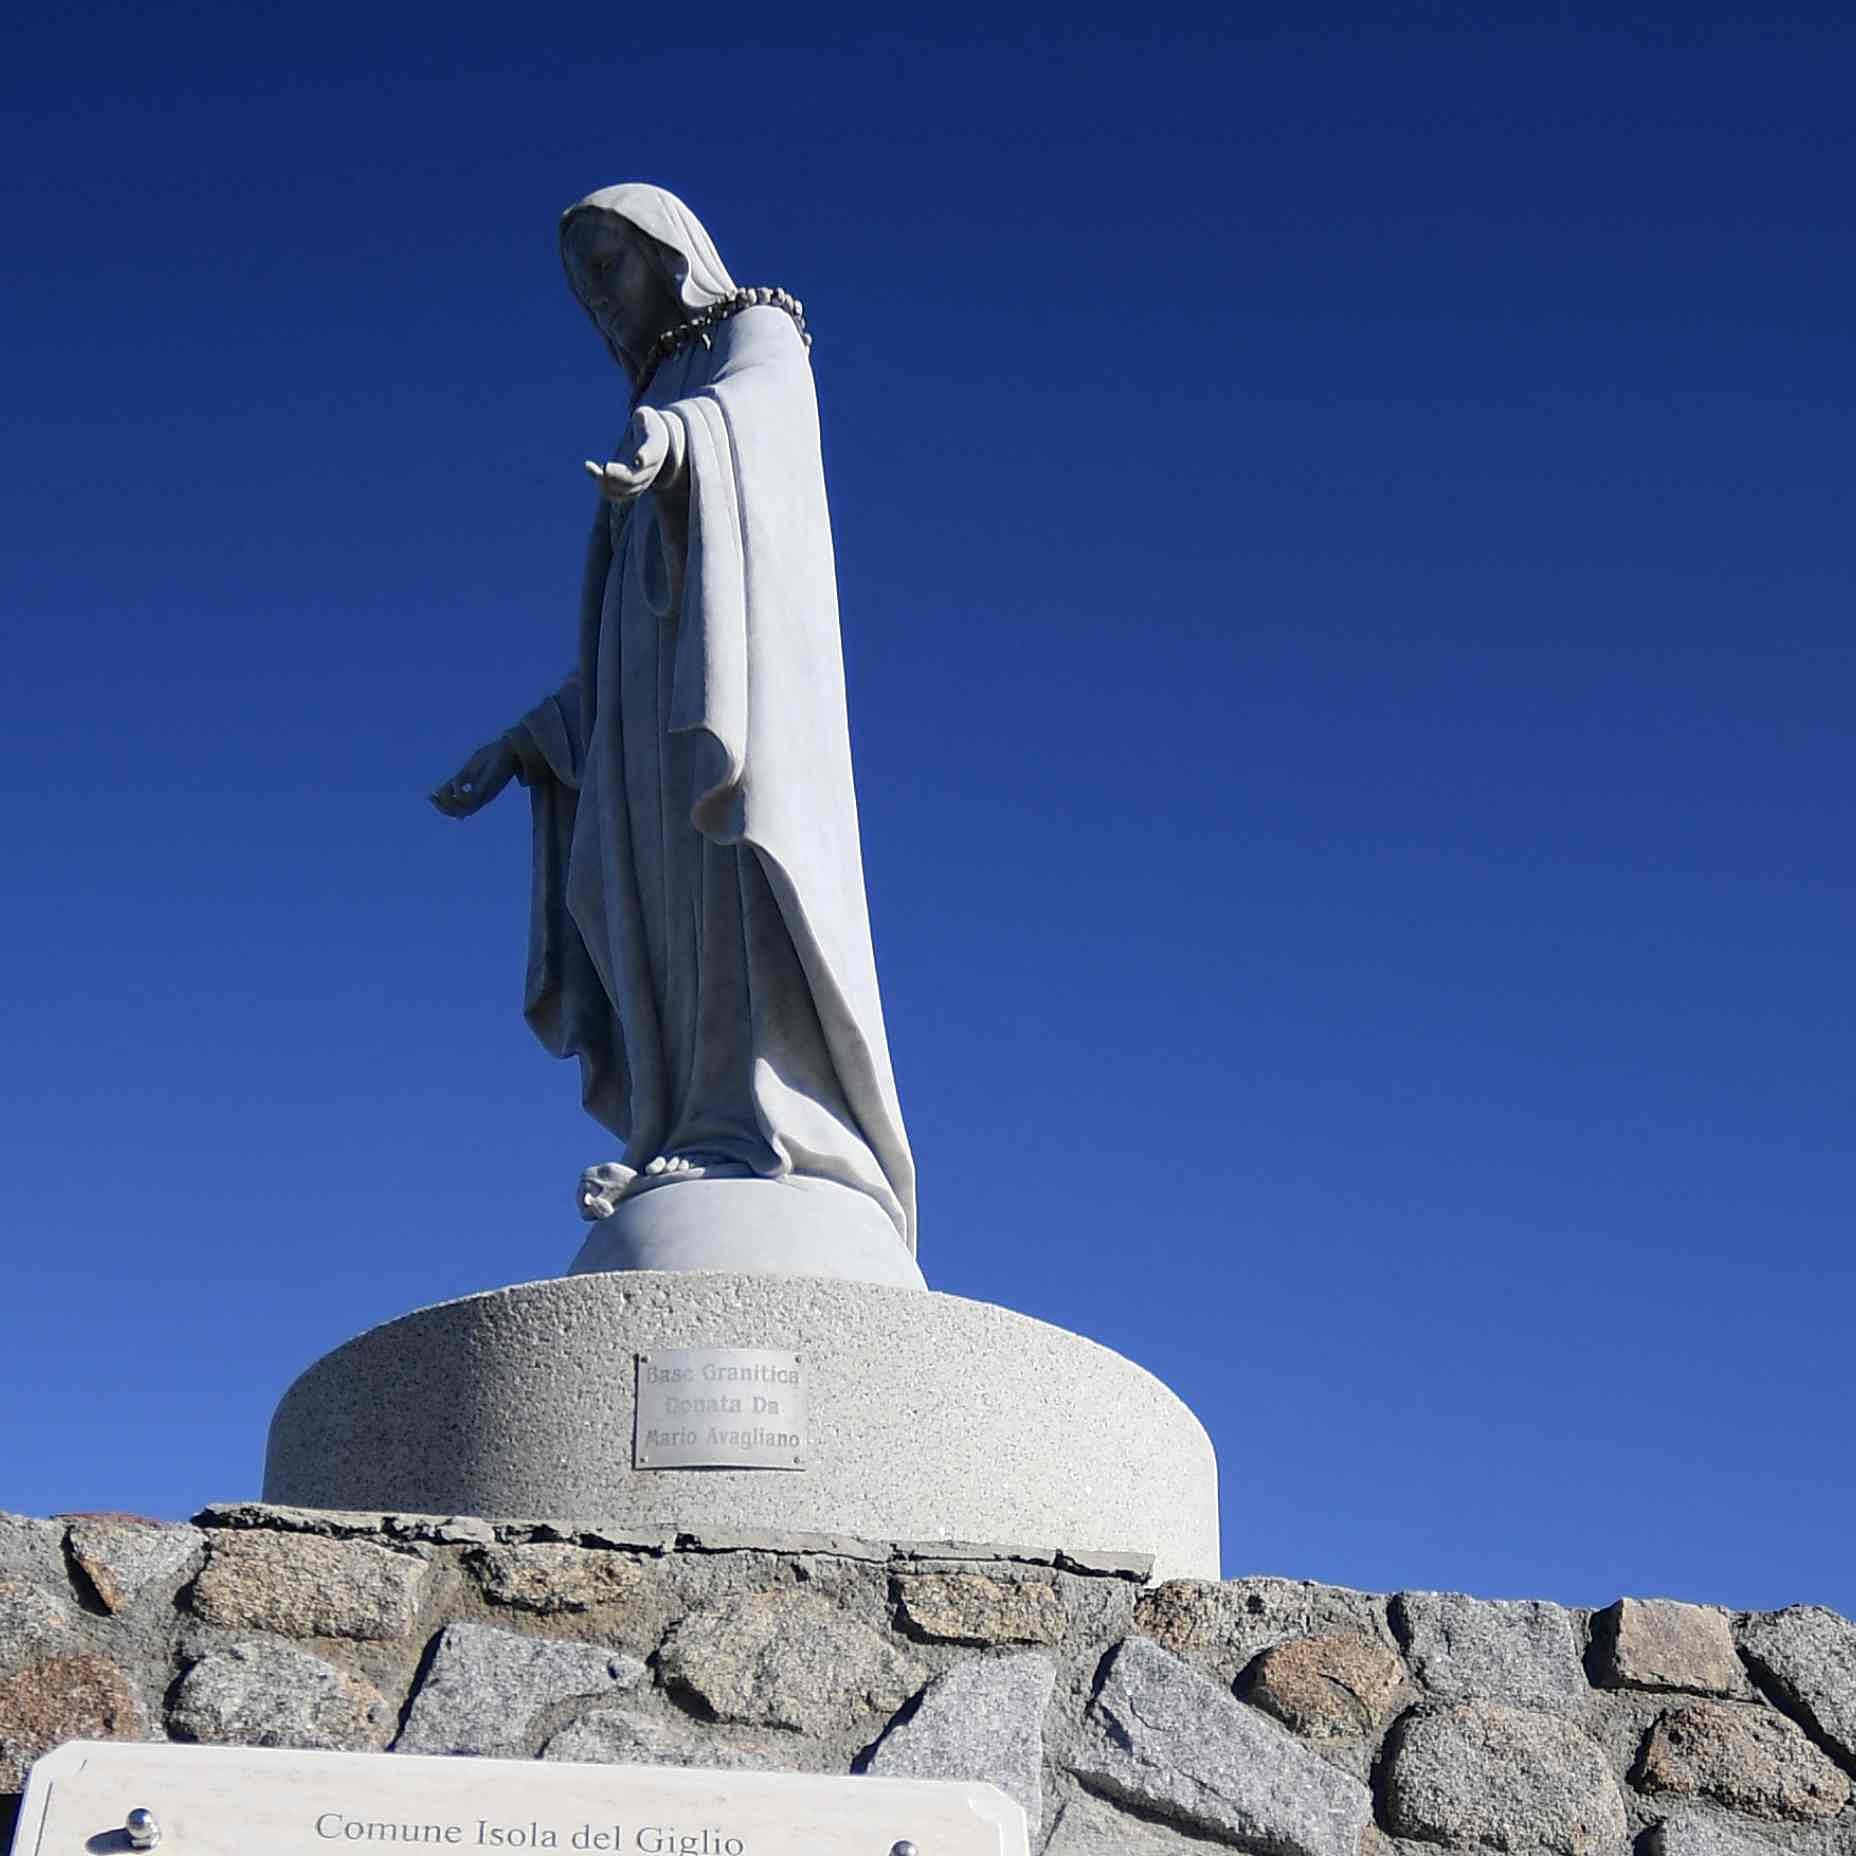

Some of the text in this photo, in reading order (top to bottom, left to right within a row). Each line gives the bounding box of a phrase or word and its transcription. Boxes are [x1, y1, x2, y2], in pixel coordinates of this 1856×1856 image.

[646, 1362, 802, 1386] Base Granitica
[644, 1426, 800, 1451] Mario Avagliano
[314, 1812, 462, 1844] Comune
[476, 1820, 557, 1848] Isola
[571, 1823, 621, 1851] del
